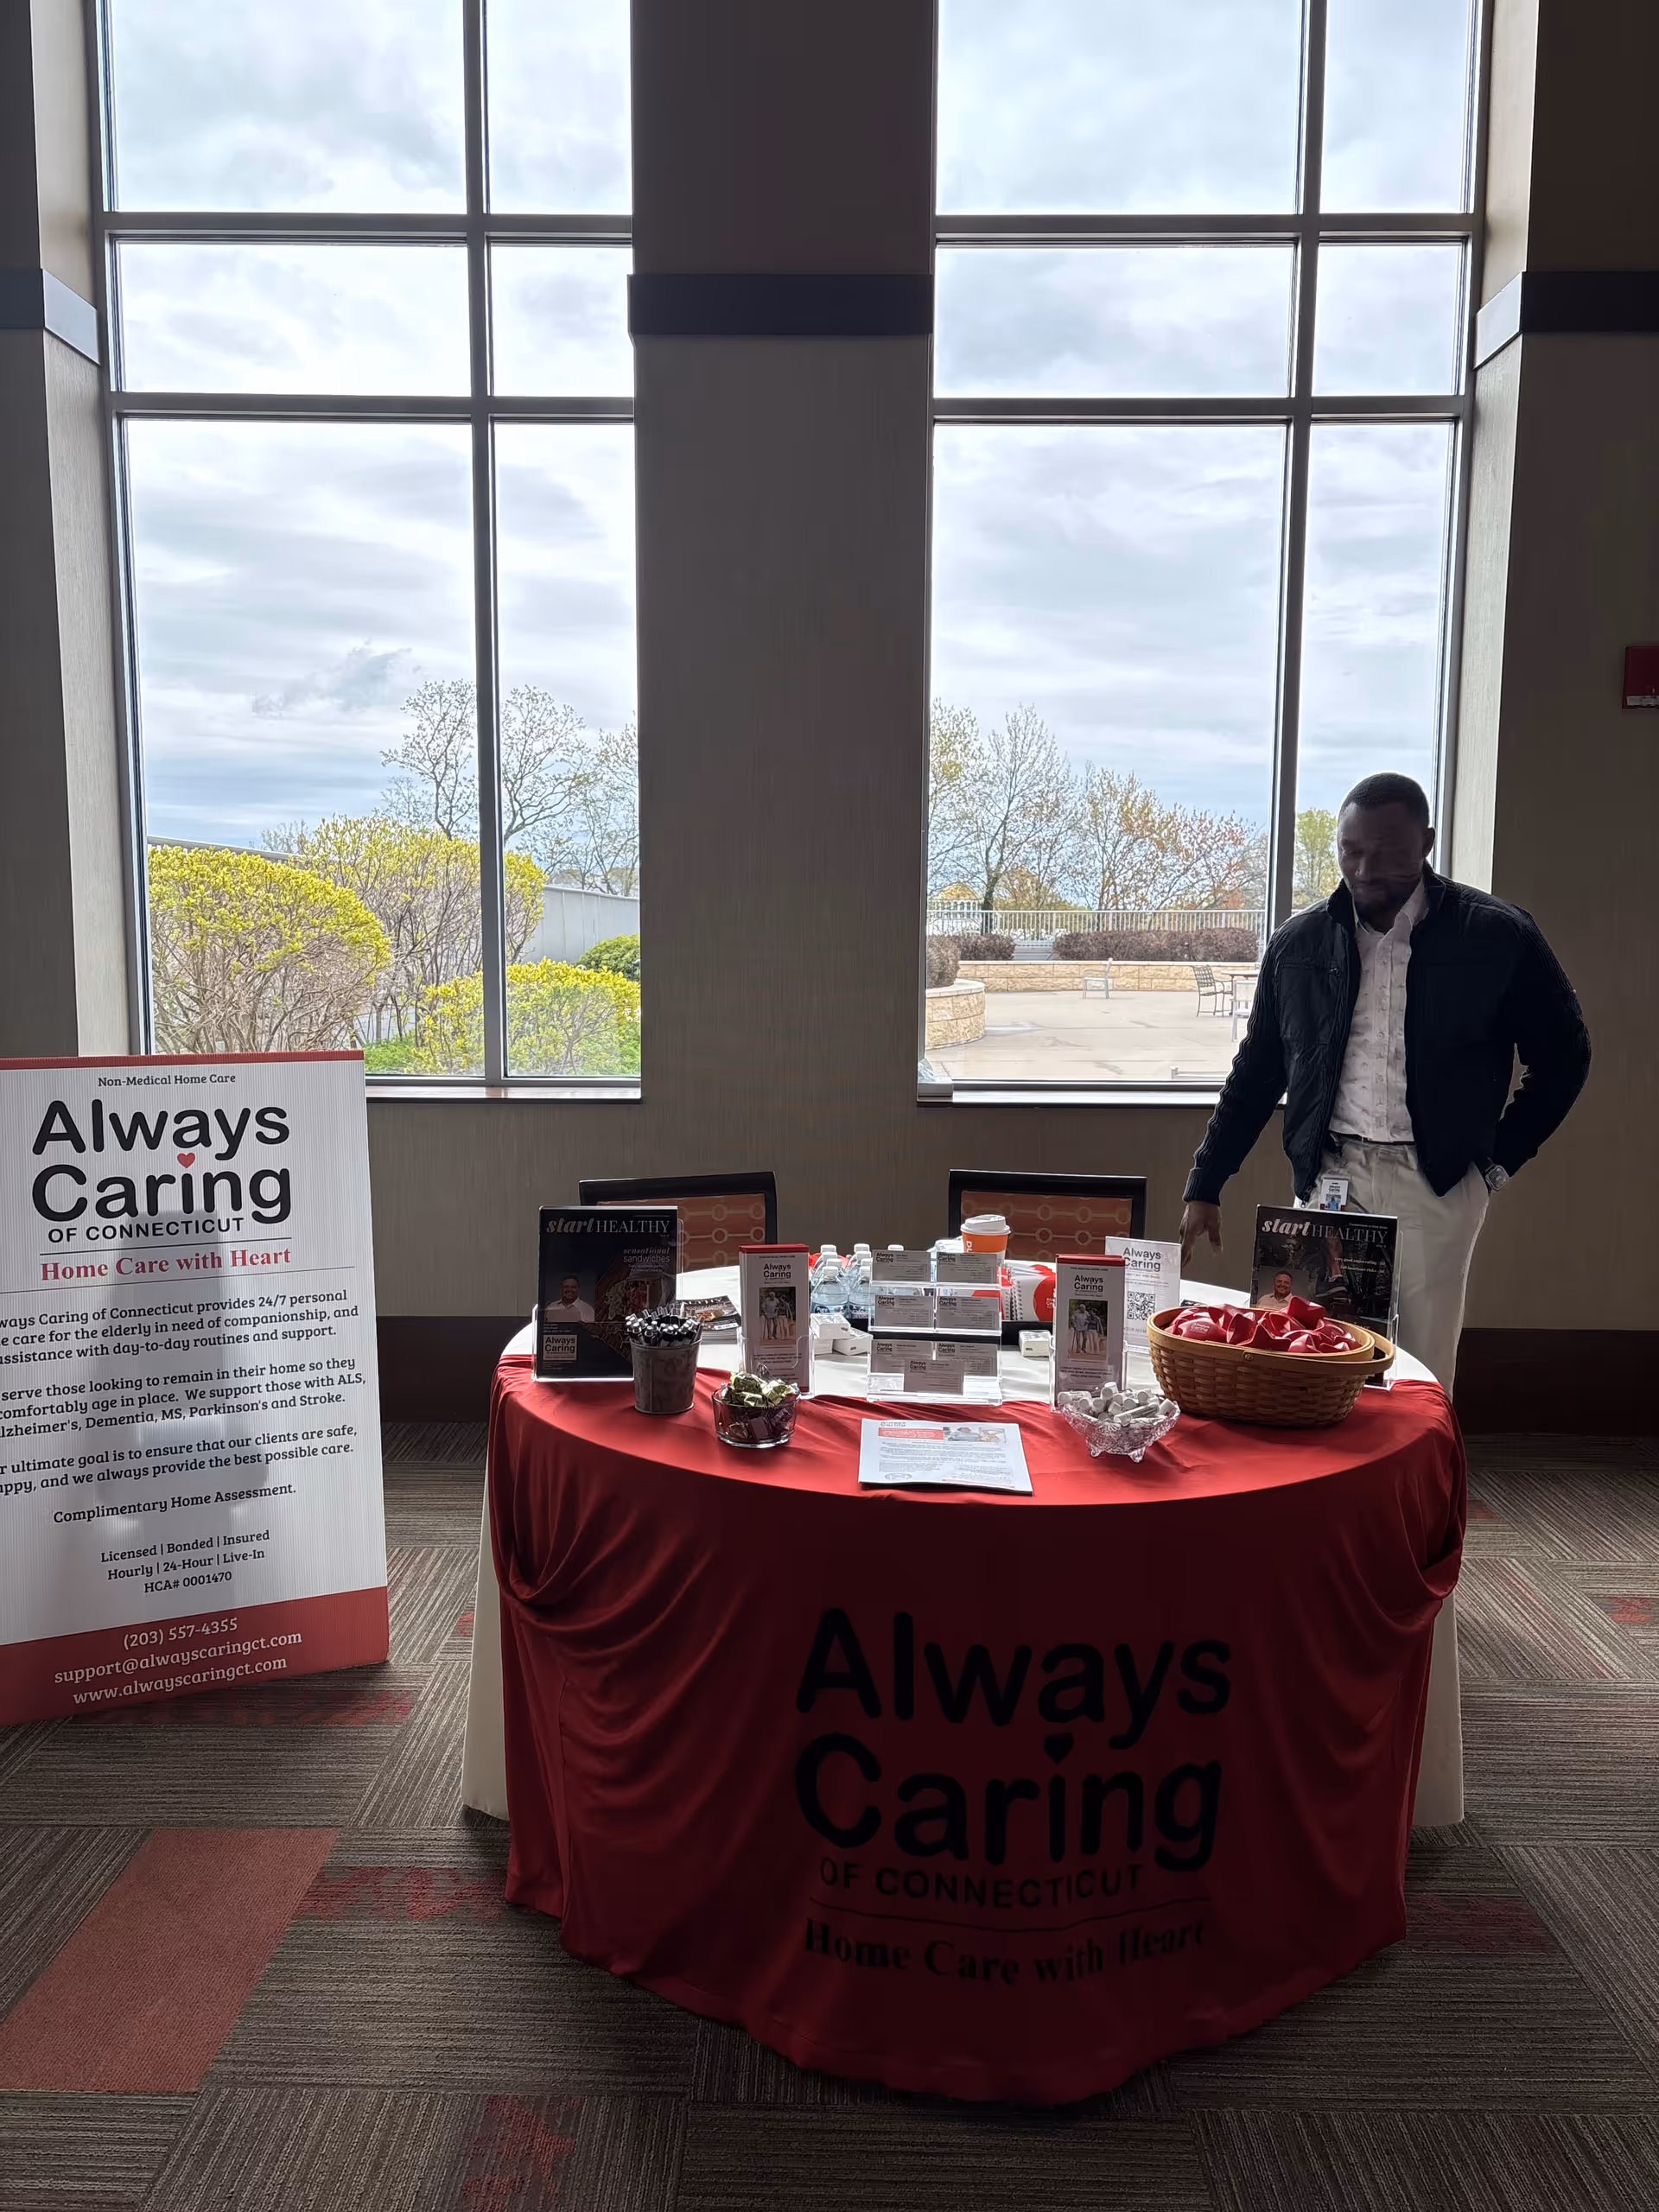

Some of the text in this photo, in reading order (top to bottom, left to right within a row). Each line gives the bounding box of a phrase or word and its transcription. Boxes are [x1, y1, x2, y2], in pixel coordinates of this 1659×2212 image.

[98, 1074, 236, 1087] Non-Medical Home Care
[32, 1098, 290, 1161] Always
[32, 1164, 291, 1224] Caring
[48, 1217, 245, 1243] OF CONNECTICUT
[41, 1248, 291, 1281] Home Care with Heart
[623, 1255, 671, 1263] sandwiches
[1123, 1247, 1162, 1262] Always
[1124, 1256, 1161, 1272] Caring
[764, 1270, 791, 1279] Caring
[1074, 1274, 1103, 1284] Always
[1074, 1282, 1103, 1293] Caring
[0, 1289, 347, 1330] ways Caring of Connecticut provides 24/7 personal
[12, 1334, 46, 1345] care
[48, 1330, 71, 1343] for
[74, 1328, 98, 1339] the
[101, 1323, 151, 1338] elderly
[154, 1321, 168, 1333] in
[172, 1319, 204, 1332] need
[207, 1317, 222, 1329] of
[224, 1308, 330, 1327] companionship,
[334, 1306, 359, 1318] and
[76, 1344, 109, 1357] with
[112, 1338, 190, 1355] day-to-day
[193, 1333, 250, 1347] routines
[252, 1329, 278, 1341] and
[282, 1325, 336, 1341] support.
[545, 1337, 575, 1345] Always
[545, 1344, 575, 1353] Caring
[2, 1357, 355, 1401] serve those looking to remain in their home so they
[92, 1399, 118, 1412] age
[120, 1395, 135, 1408] in
[137, 1393, 179, 1408] place.
[185, 1389, 206, 1401] We
[209, 1382, 263, 1400] support
[265, 1381, 302, 1393] those
[304, 1376, 334, 1389] with
[337, 1372, 366, 1385] ALS,
[0, 1392, 346, 1438] lzheimer's, Dementia, MS, Parkinson's and Stroke.
[11, 1457, 74, 1473] ultimate
[78, 1451, 110, 1468] goal
[112, 1449, 124, 1462] is
[128, 1448, 142, 1460] to
[145, 1442, 193, 1458] ensure
[196, 1439, 226, 1452] that
[228, 1437, 251, 1448] our
[255, 1432, 298, 1446] clients
[302, 1429, 324, 1440] are
[326, 1424, 358, 1439] safe,
[0, 1444, 353, 1496] ppy, and we always provide the best possible care.
[53, 1484, 296, 1523] Complimentary Home Assessment.
[100, 1544, 157, 1563] Licensed
[166, 1537, 213, 1554] Bonded
[223, 1530, 270, 1546] Insured
[107, 1564, 153, 1580] Hourly
[162, 1555, 213, 1573] 24-Hour
[222, 1548, 265, 1564] Live-In
[143, 1571, 232, 1593] HCA# 0001470
[124, 1617, 238, 1651] (203) 557-4355
[54, 1631, 302, 1684] support@alwayscaringct.com
[73, 1657, 288, 1705] www.alwayscaringct.com
[797, 1608, 1232, 1750] Always
[796, 1732, 1222, 1872] Caring
[820, 1856, 1142, 1909] OF CONNECTICUT
[805, 1916, 1205, 1985] Home Care with Heart
